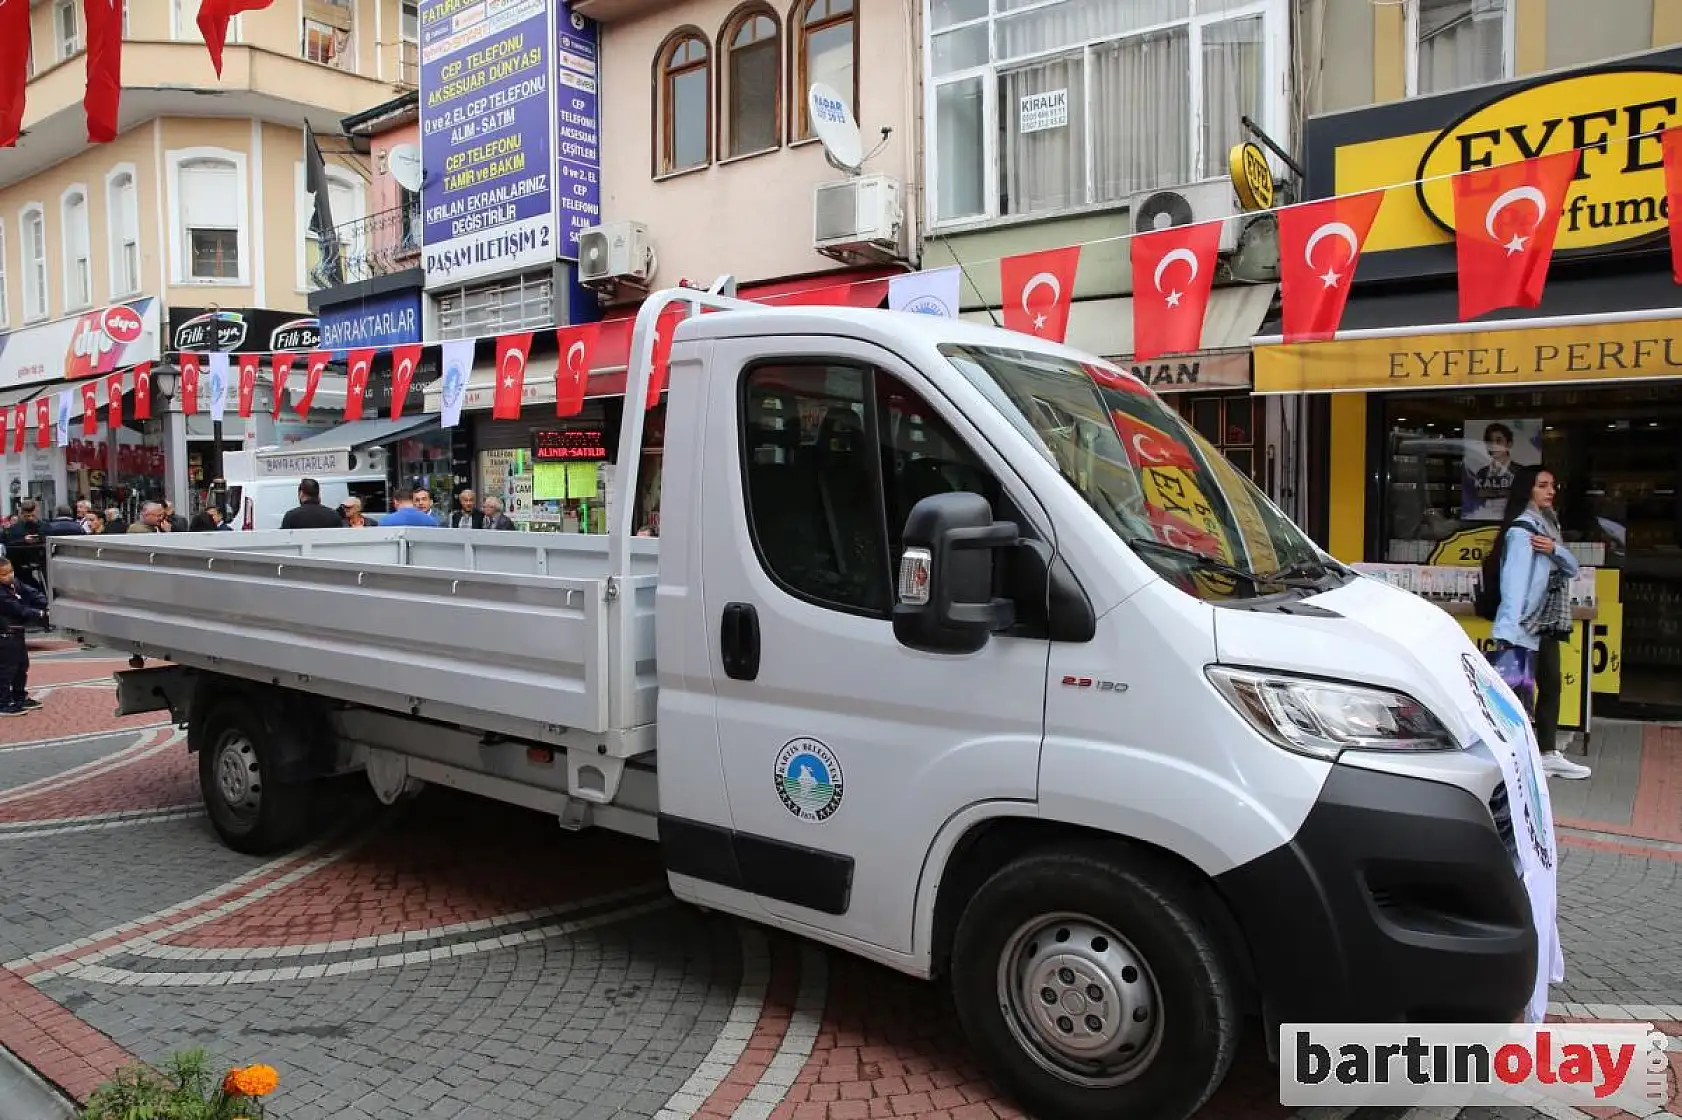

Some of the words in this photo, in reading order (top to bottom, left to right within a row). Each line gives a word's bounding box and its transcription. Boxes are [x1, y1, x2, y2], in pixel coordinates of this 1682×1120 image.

[440, 60, 462, 82] CEP
[467, 33, 524, 72] TELEFONU
[428, 69, 486, 106] AKSESUAR
[467, 98, 487, 118] CEP
[489, 74, 547, 109] TELEFONU
[446, 152, 467, 172] CEP
[468, 133, 522, 165] TELEFONU
[477, 167, 489, 182] ve
[561, 197, 599, 215] TELEFONU
[427, 244, 472, 276] PAŞAM
[475, 226, 536, 262] İLETİŞİM
[540, 224, 549, 248] 2
[107, 315, 139, 333] dyo
[323, 307, 416, 346] BAYRAKTARLAR
[1388, 346, 1519, 379] EYFEL
